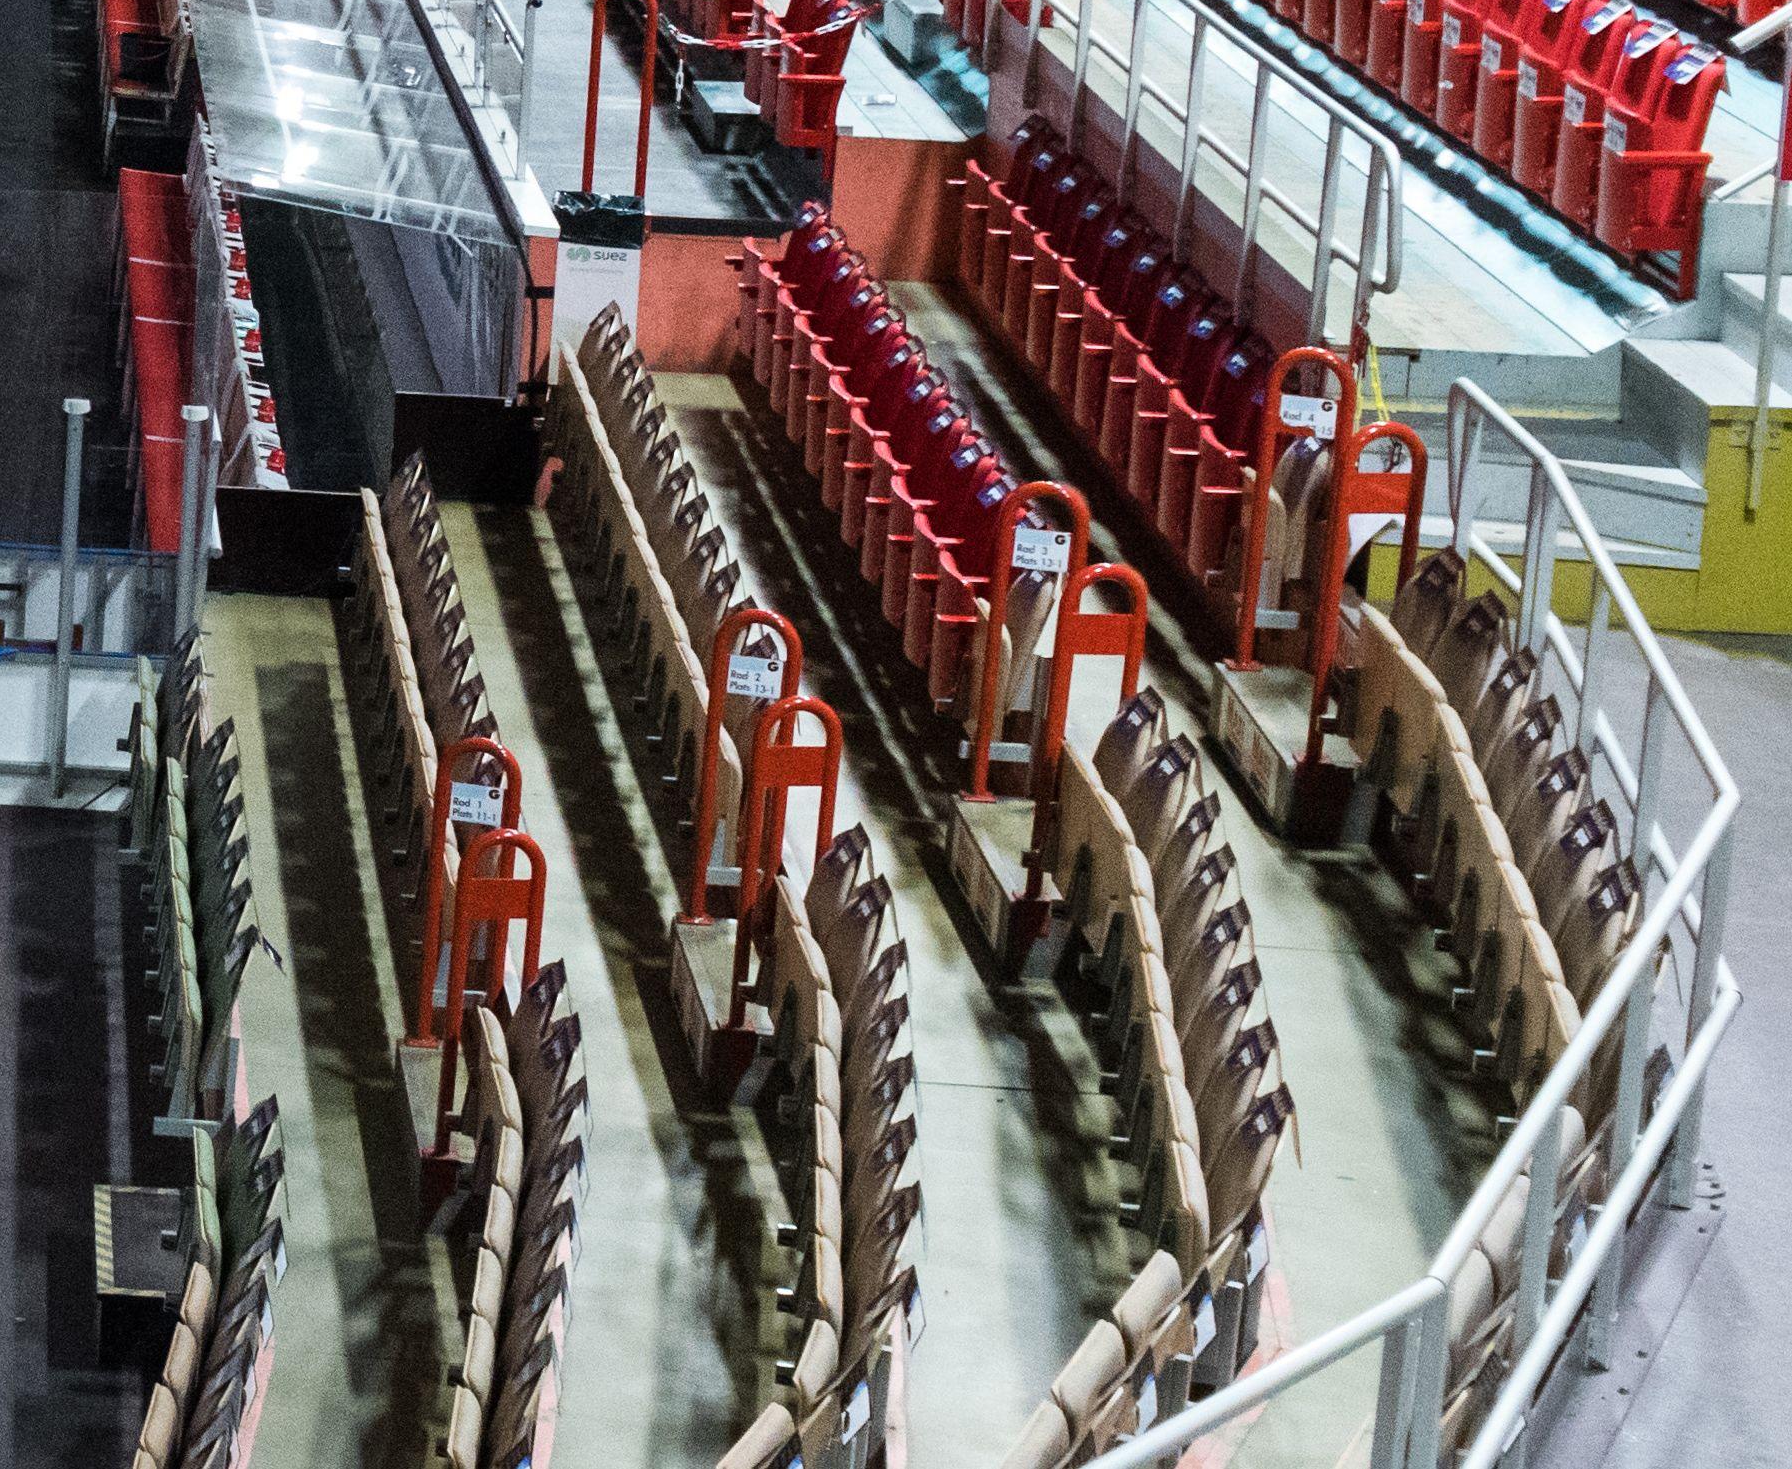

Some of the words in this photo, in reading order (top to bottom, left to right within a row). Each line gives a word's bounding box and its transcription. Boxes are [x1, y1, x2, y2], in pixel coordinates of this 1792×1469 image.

[592, 251, 628, 262] suez
[1321, 401, 1333, 412] G
[1055, 534, 1066, 545] G
[1041, 547, 1048, 555] 3
[767, 661, 779, 672] G
[754, 673, 761, 682] 2
[488, 789, 501, 800] G
